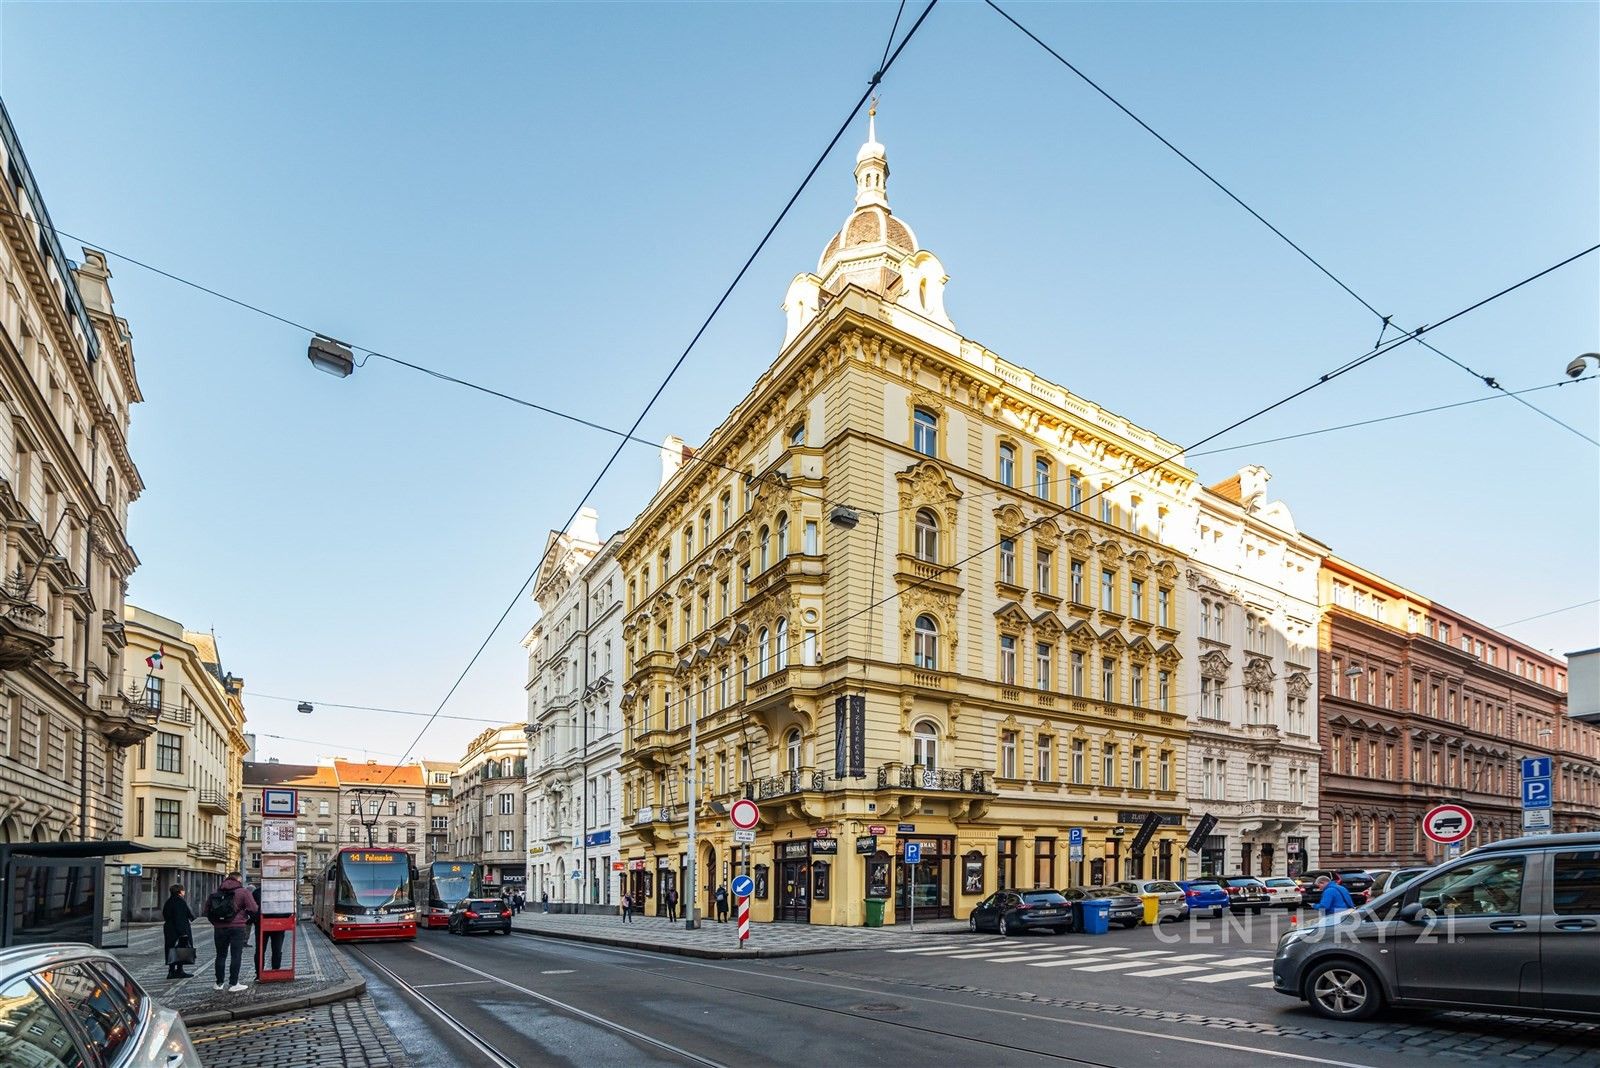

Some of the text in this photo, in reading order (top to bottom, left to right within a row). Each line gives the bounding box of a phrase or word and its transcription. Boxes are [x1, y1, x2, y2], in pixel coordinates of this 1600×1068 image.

[1528, 782, 1545, 800] P
[1071, 830, 1080, 840] P
[908, 845, 917, 857] P
[351, 854, 360, 862] 14
